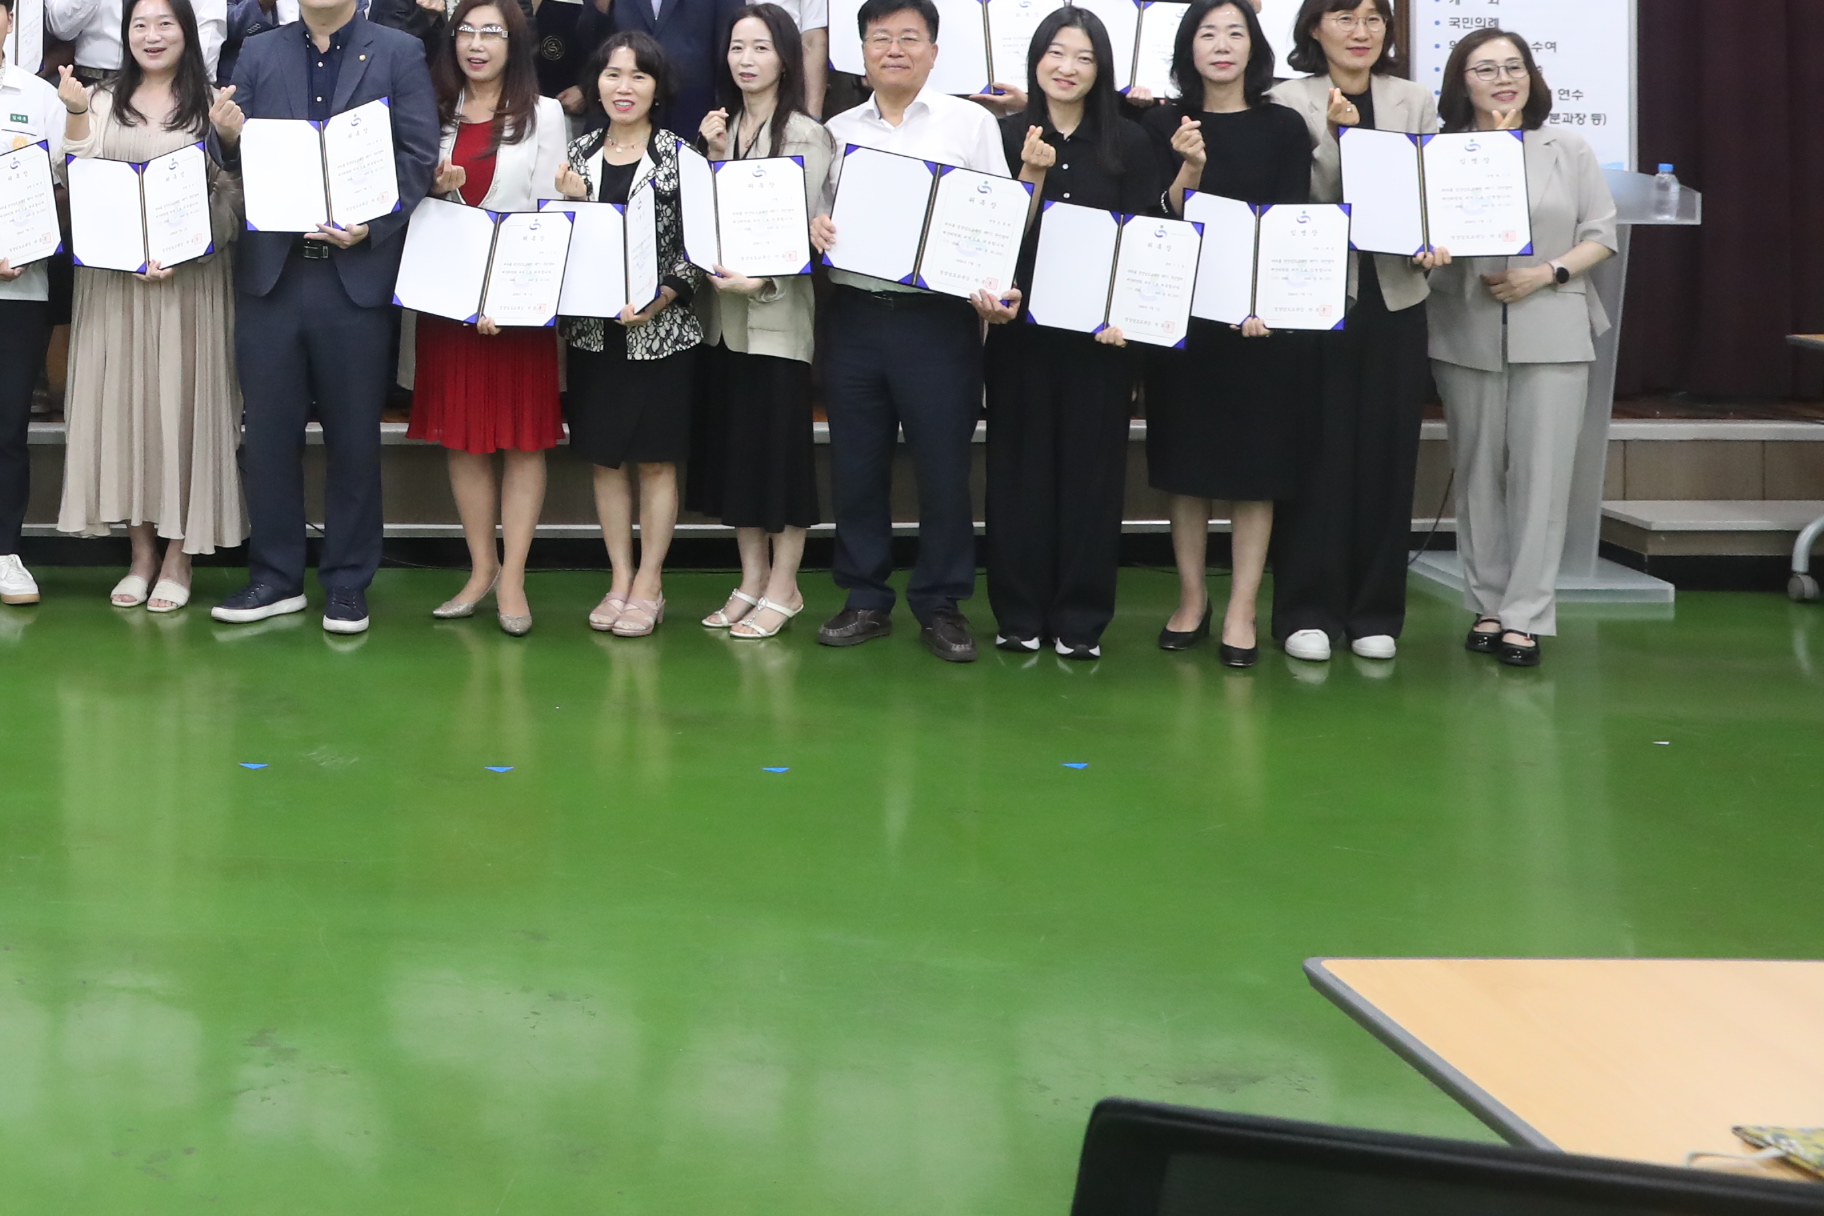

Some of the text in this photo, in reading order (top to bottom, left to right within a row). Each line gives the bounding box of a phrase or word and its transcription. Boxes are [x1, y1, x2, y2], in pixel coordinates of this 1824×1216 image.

[1449, 17, 1500, 29] 국민의례
[1531, 41, 1557, 53] 수여
[1557, 88, 1584, 101] 연수
